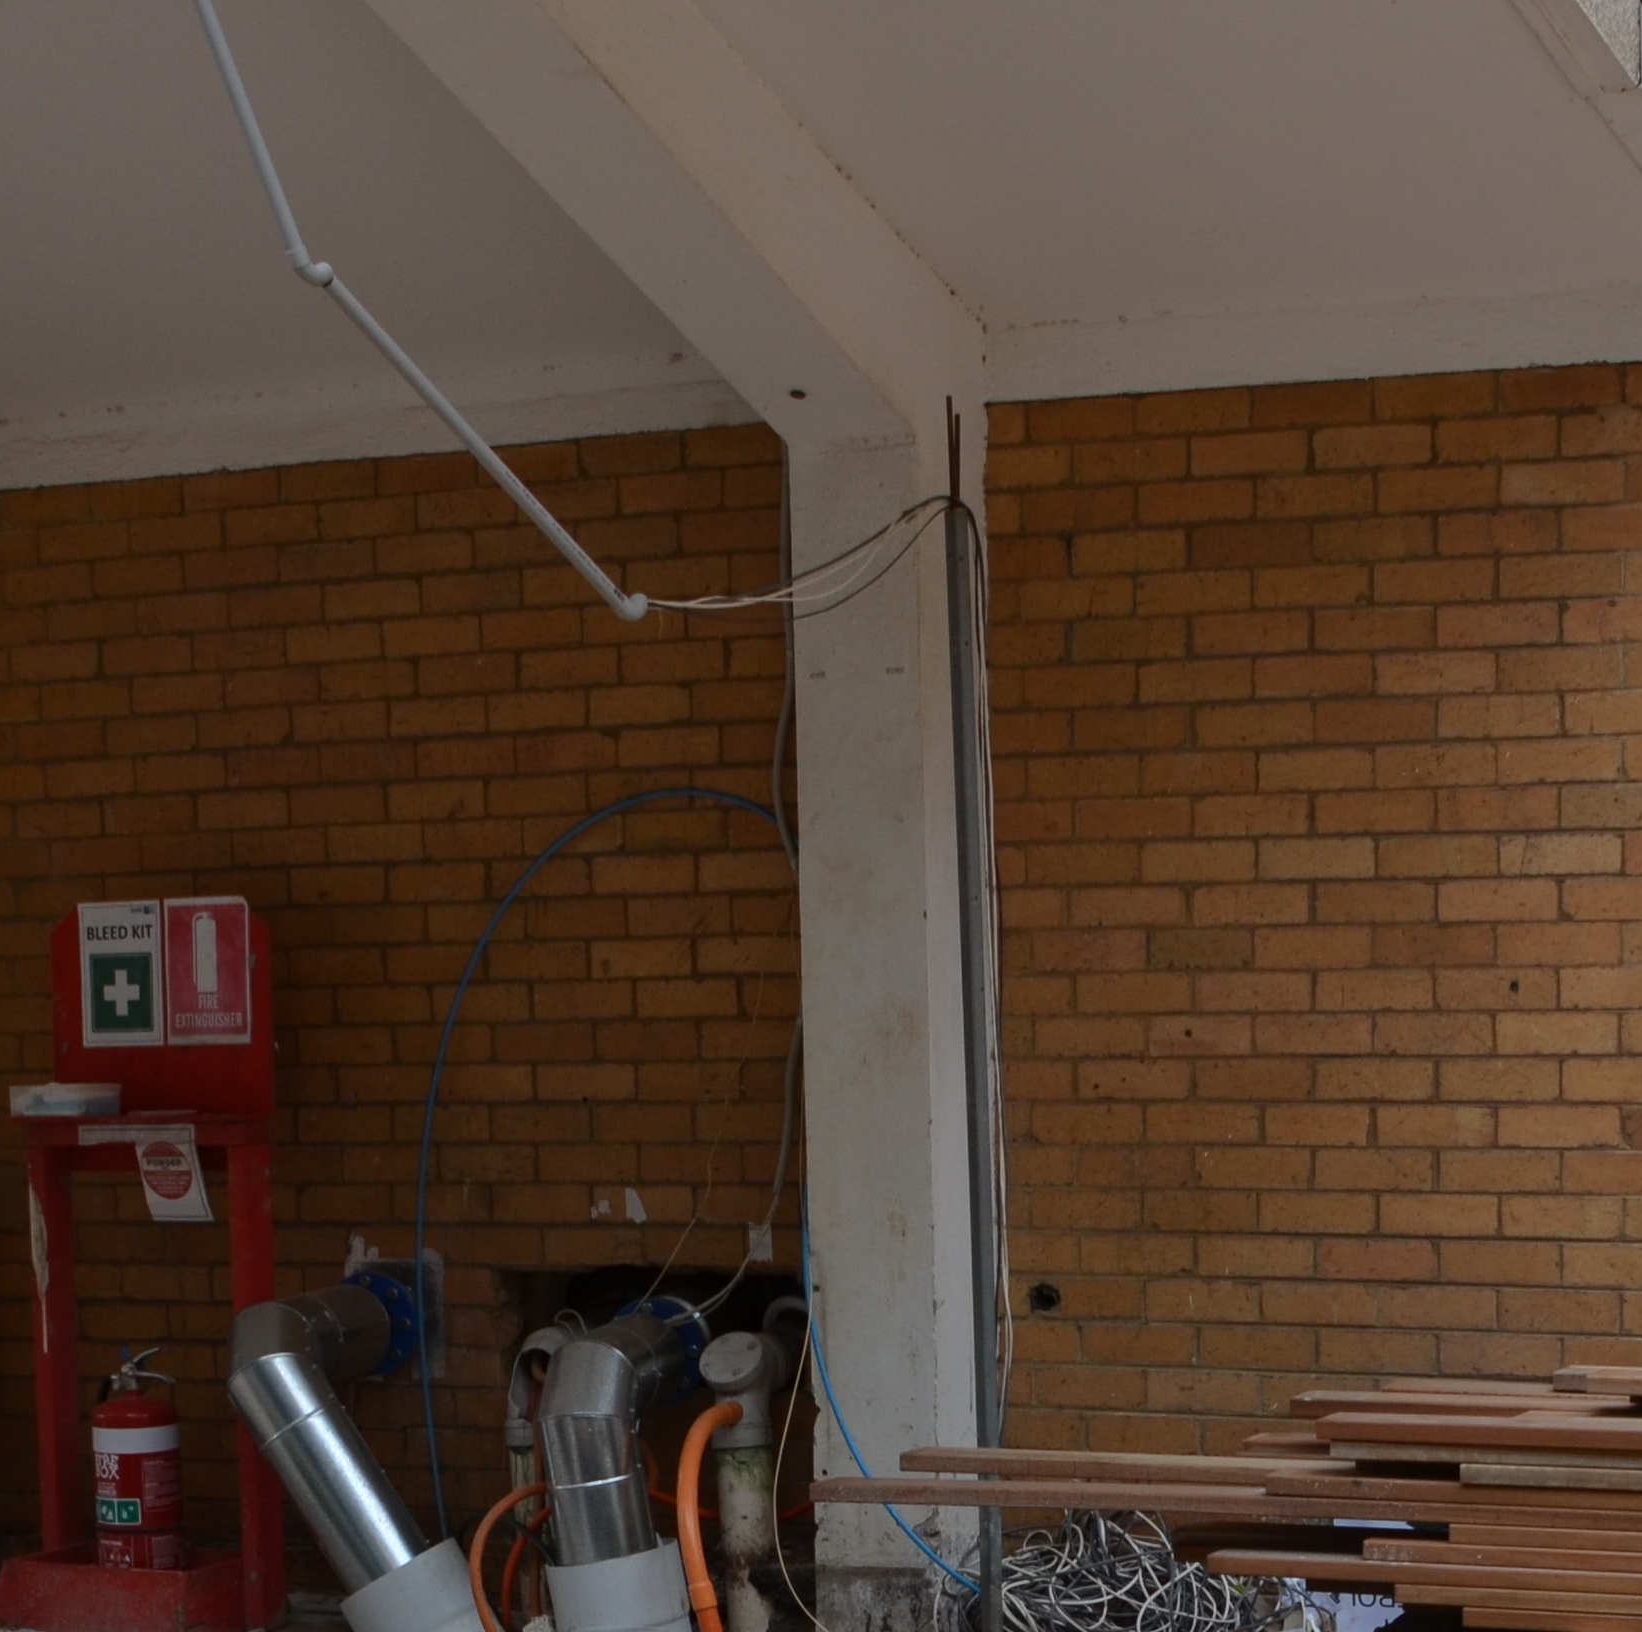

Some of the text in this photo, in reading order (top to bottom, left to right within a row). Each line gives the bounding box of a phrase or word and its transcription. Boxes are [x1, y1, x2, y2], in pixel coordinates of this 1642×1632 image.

[86, 924, 153, 941] BLEED KIT
[198, 994, 219, 1009] FIRE
[175, 1012, 243, 1028] EXTINGUISHER
